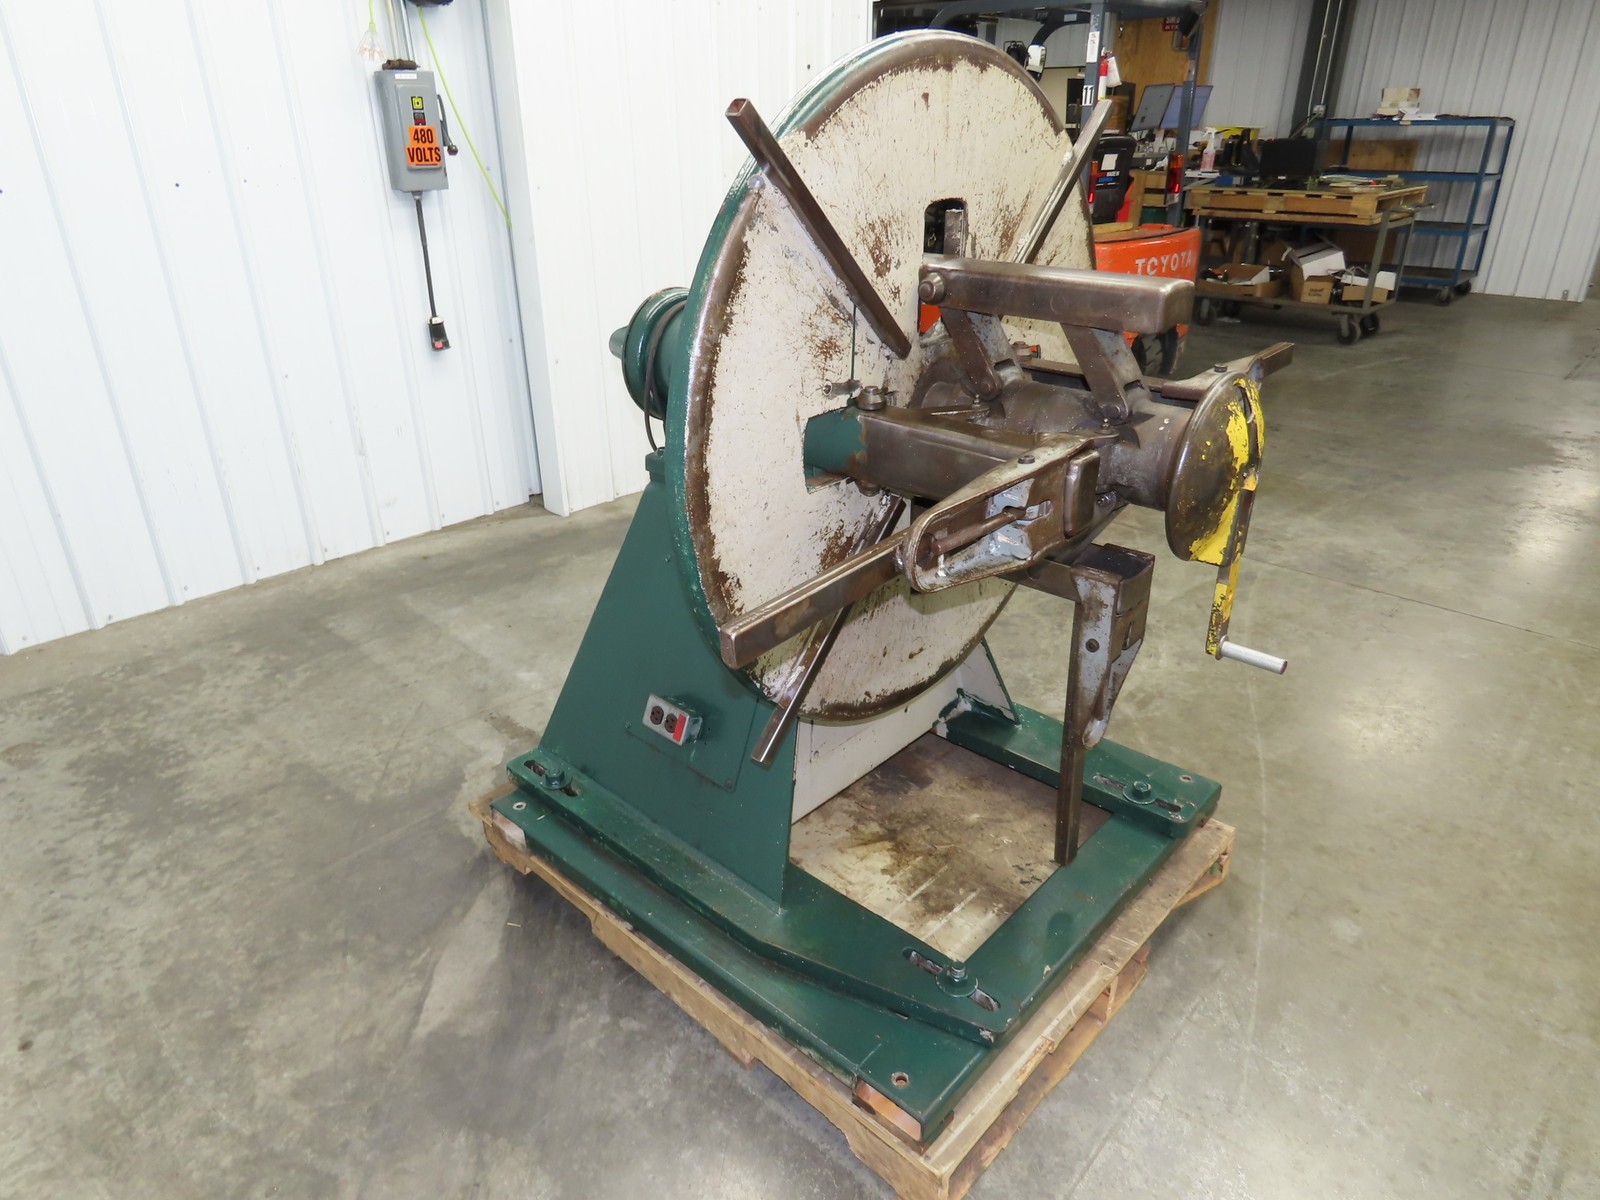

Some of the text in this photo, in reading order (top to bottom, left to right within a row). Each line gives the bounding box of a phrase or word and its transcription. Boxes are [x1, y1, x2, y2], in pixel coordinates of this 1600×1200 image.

[413, 128, 434, 144] 480
[407, 147, 442, 162] VOLTS
[1135, 250, 1193, 276] TOYOTA
